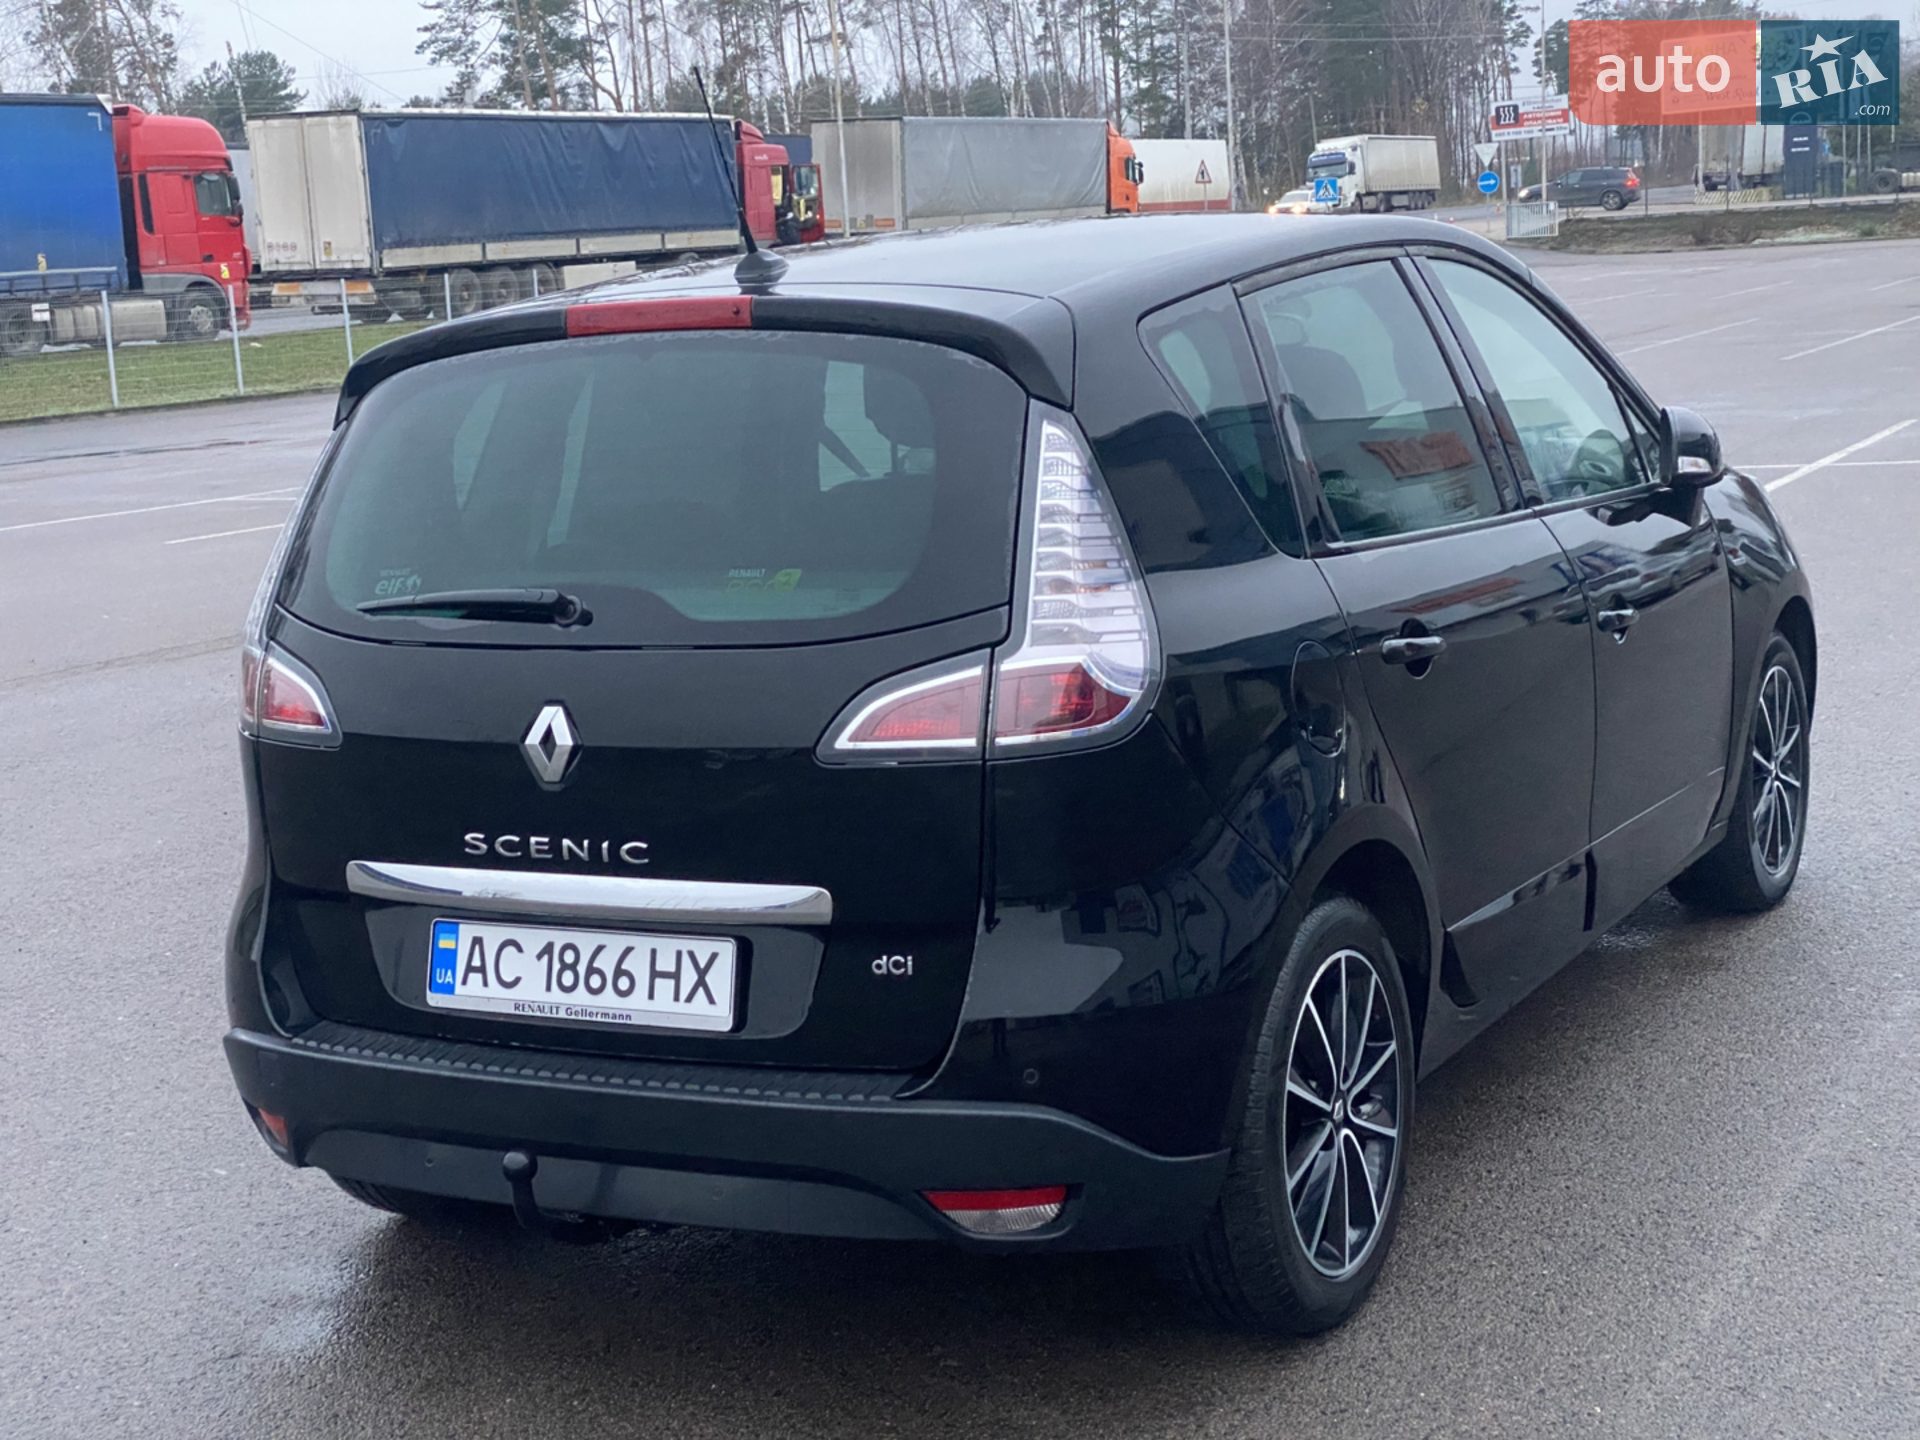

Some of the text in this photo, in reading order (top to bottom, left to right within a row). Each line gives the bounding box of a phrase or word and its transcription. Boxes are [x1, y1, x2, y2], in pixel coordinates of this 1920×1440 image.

[728, 568, 766, 578] RENAULT
[464, 832, 650, 864] SCENIC
[461, 936, 720, 1005] AC 1866 HX
[871, 955, 913, 975] dCi
[436, 968, 453, 984] UA
[514, 1002, 632, 1021] RENAULT Gellermann
